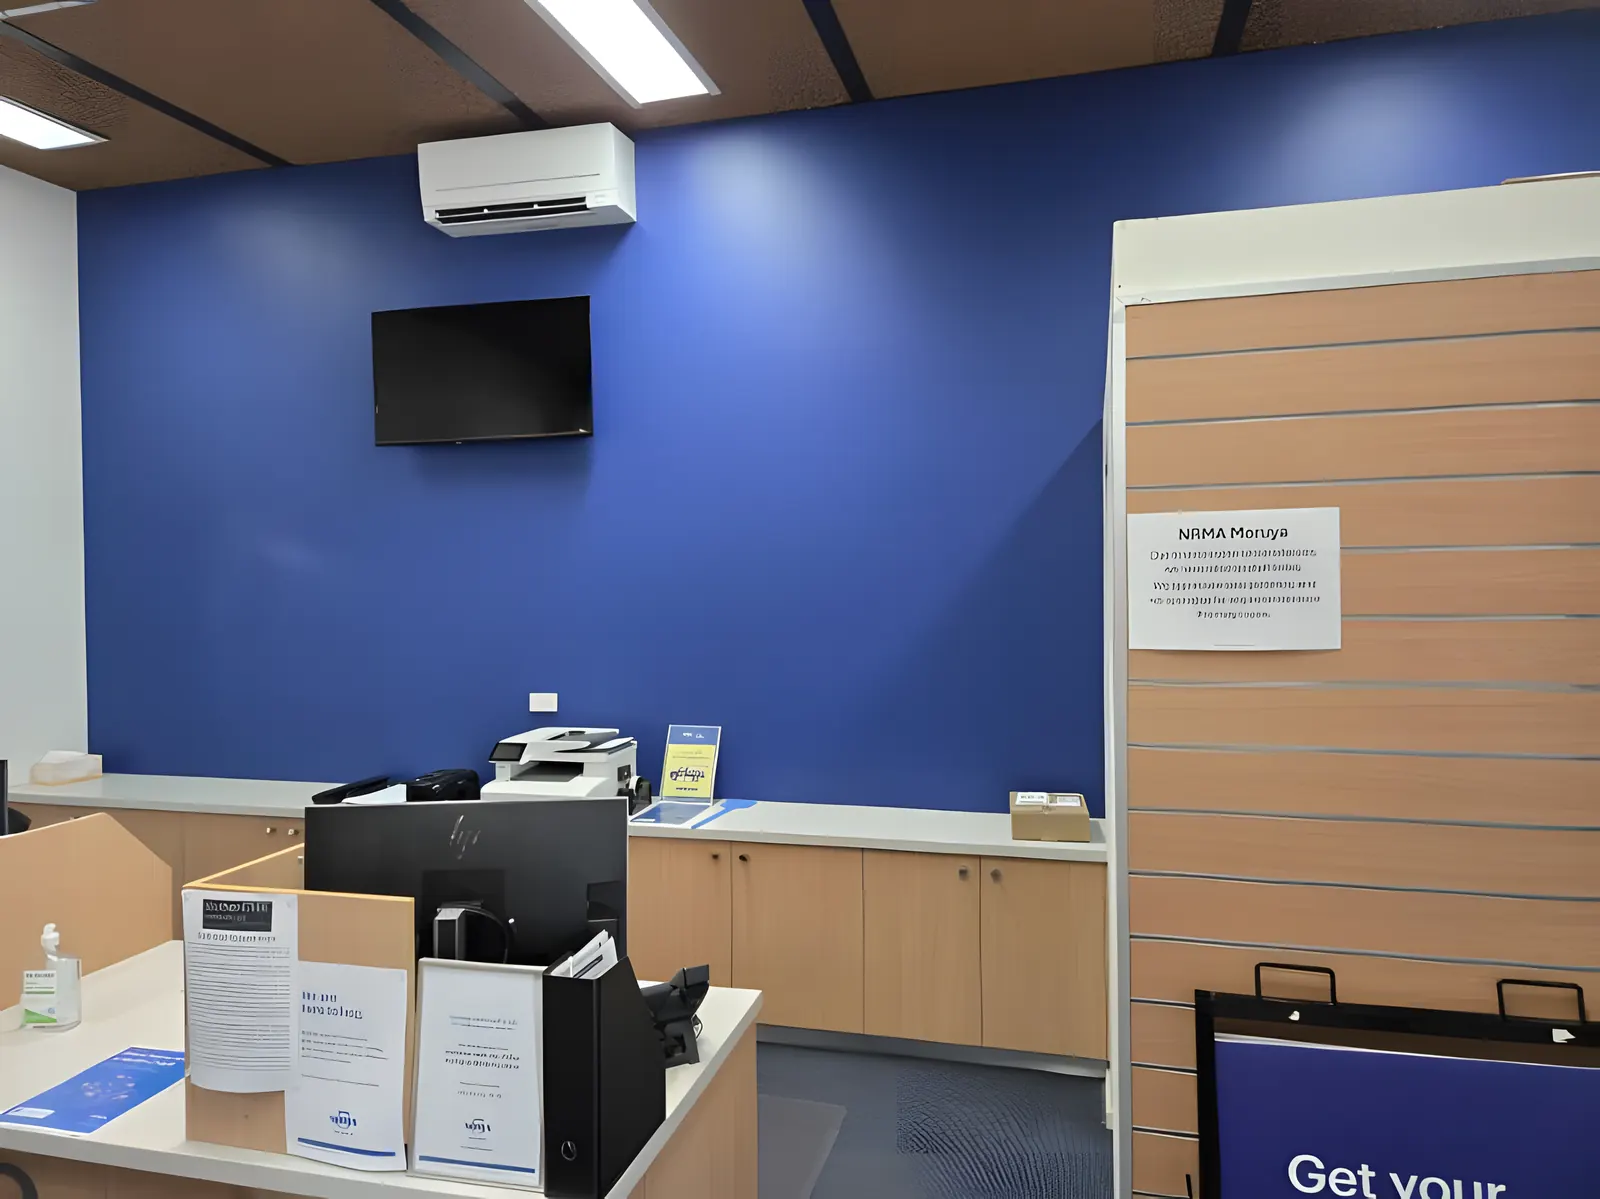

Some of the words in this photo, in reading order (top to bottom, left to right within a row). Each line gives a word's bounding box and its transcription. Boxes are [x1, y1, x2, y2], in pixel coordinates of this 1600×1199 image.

[1179, 527, 1226, 540] NRMA
[1230, 526, 1288, 541] Moruya
[1288, 1154, 1376, 1199] Get
